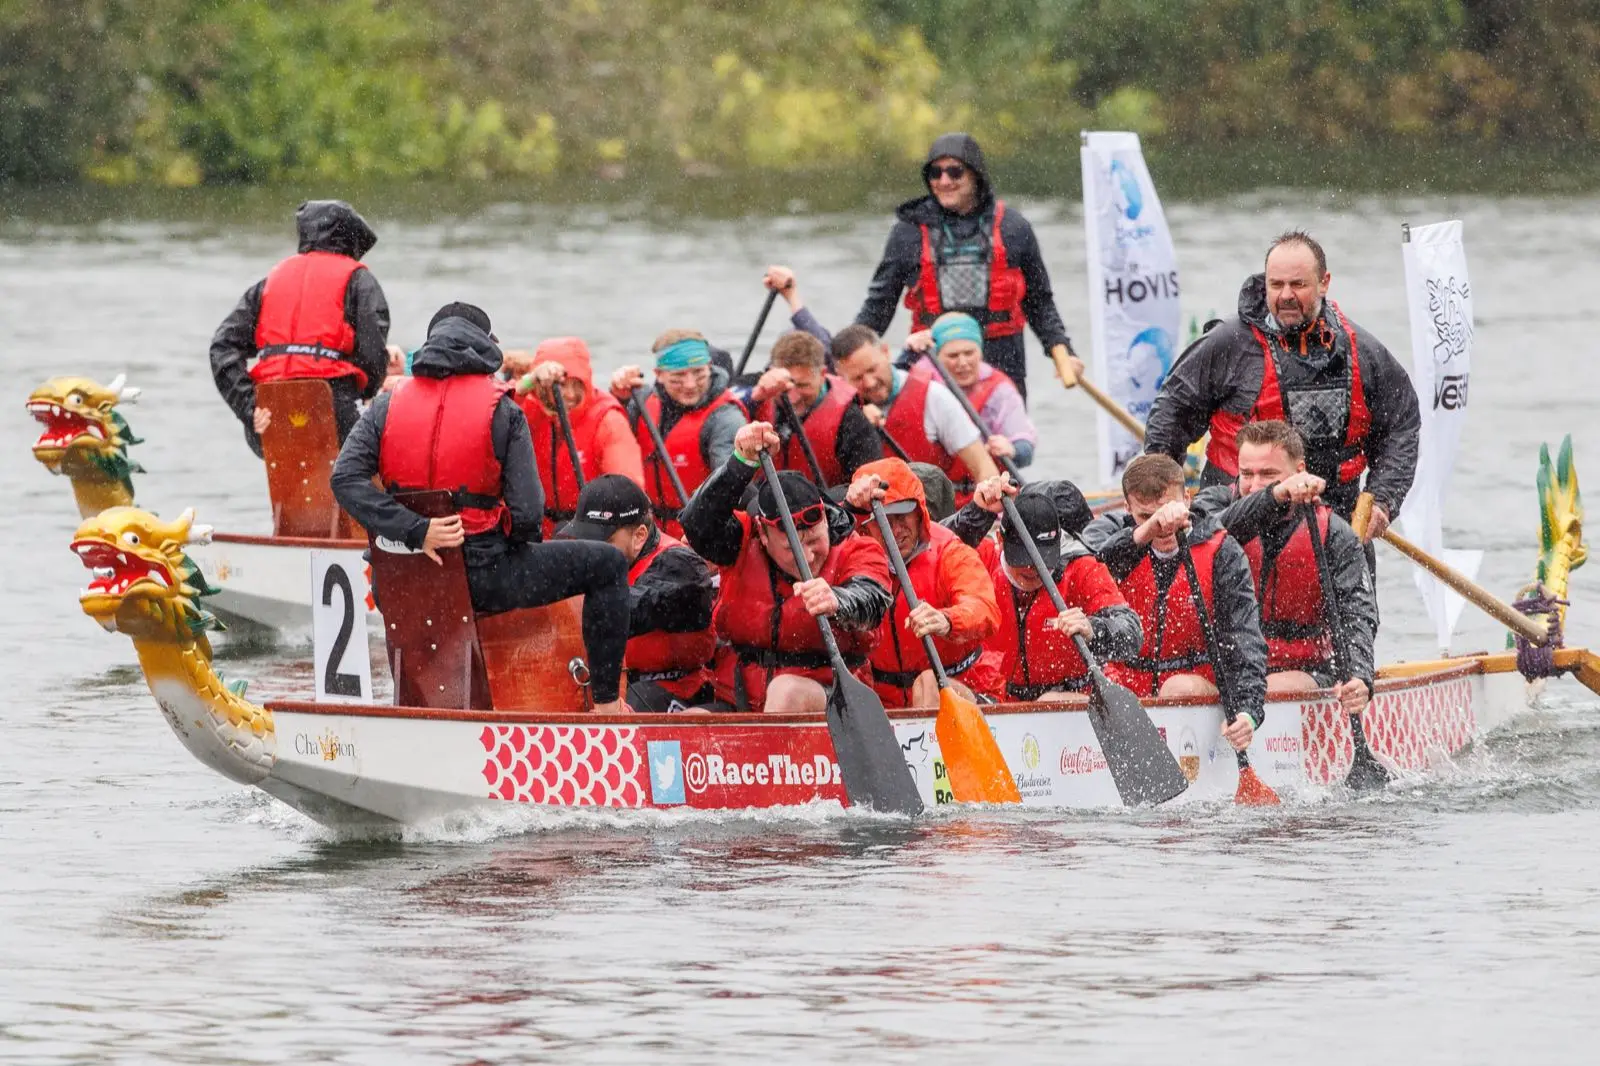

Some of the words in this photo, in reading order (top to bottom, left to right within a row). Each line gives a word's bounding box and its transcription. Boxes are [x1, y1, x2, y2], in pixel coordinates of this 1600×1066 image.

[1105, 270, 1179, 305] HOVIS
[322, 563, 362, 697] 2
[295, 732, 355, 761] Chapion
[1264, 731, 1300, 758] worldpay
[1014, 772, 1052, 789] Budweiser
